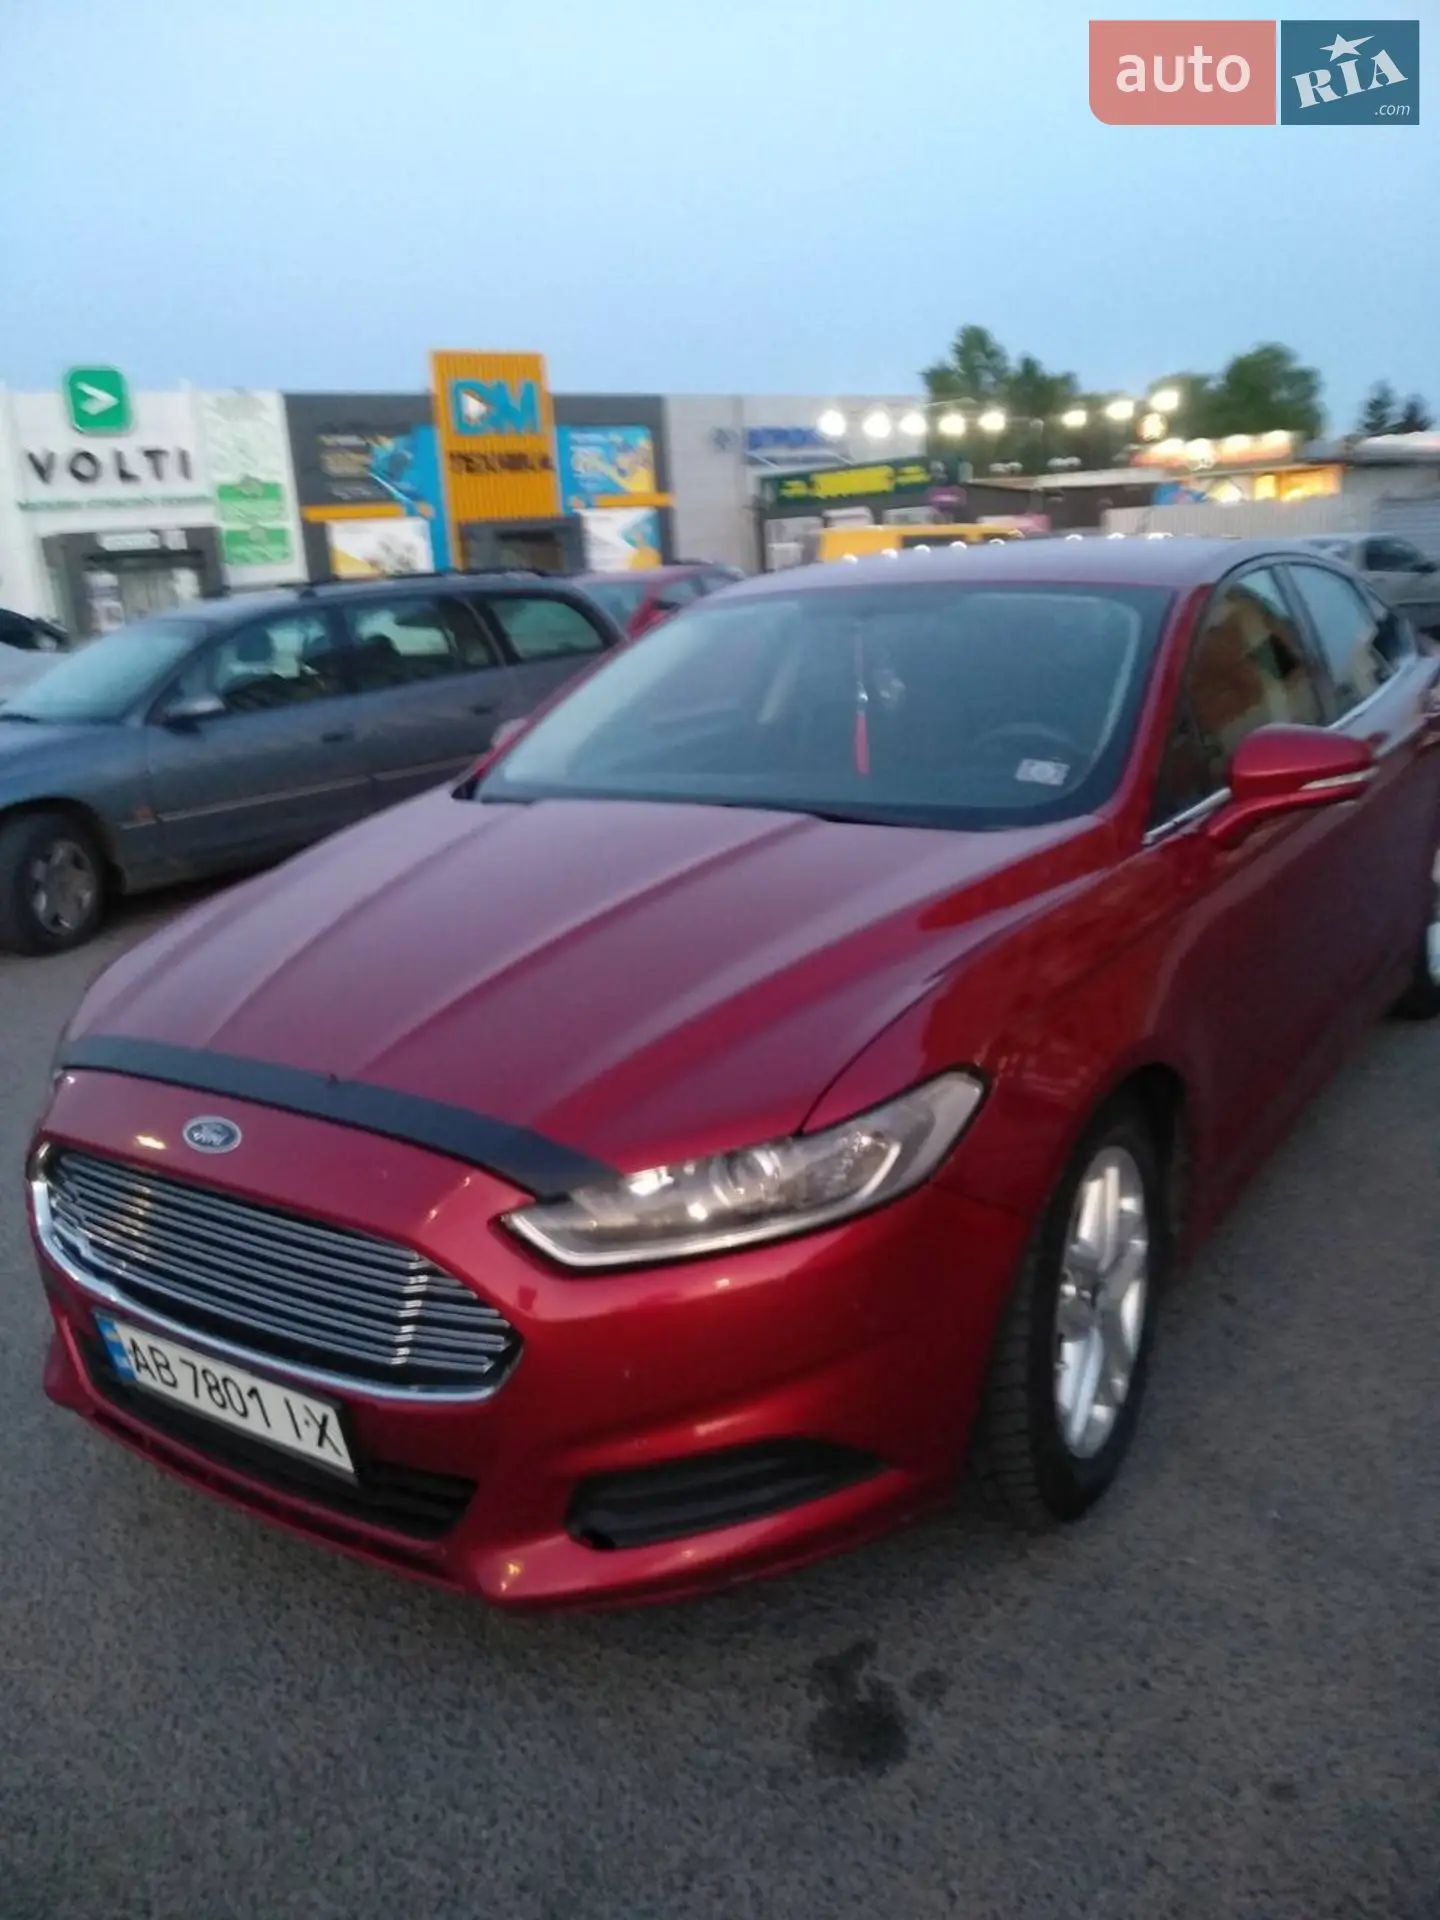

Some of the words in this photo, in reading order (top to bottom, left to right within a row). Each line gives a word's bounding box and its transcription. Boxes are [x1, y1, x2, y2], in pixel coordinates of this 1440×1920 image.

[27, 448, 193, 485] VOLTI
[128, 1337, 178, 1389] AB
[179, 1355, 272, 1430] 7801
